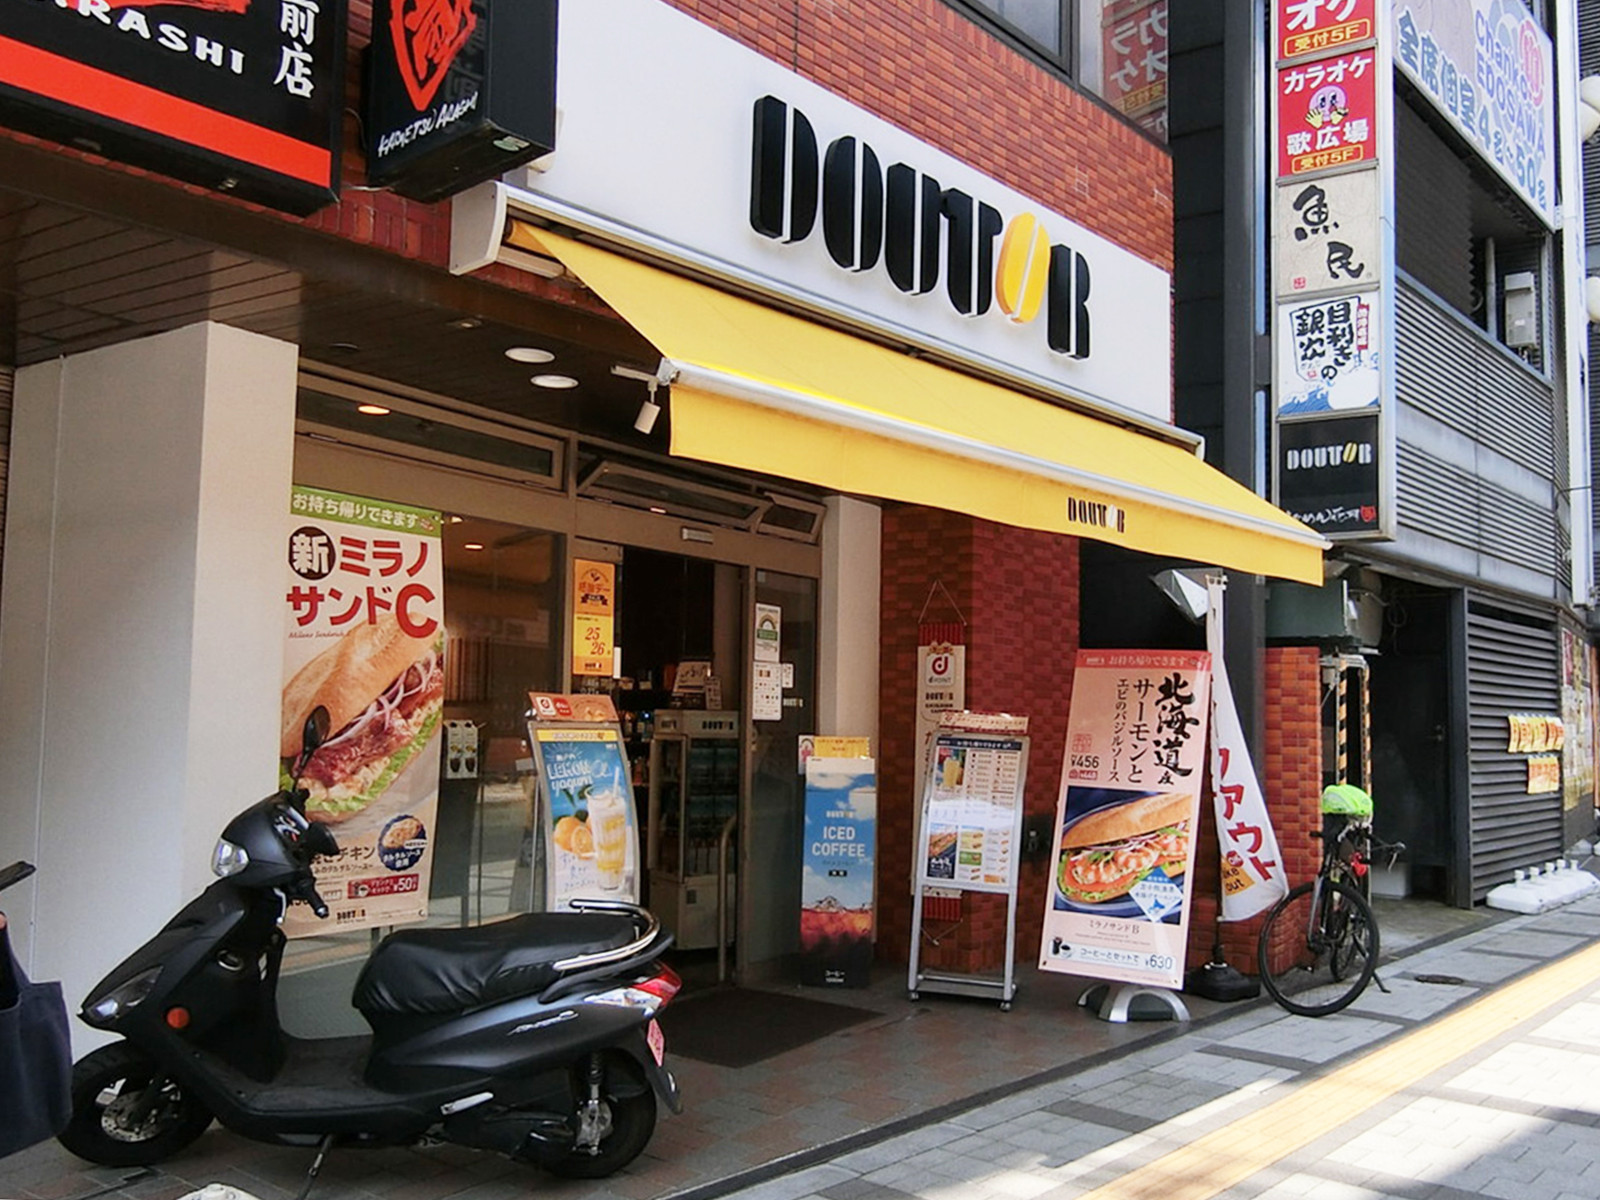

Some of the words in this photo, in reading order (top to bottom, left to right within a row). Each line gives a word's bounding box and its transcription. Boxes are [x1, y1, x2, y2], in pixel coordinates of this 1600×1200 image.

[54, 0, 244, 74] RASHI
[1294, 24, 1360, 52] 受付5F
[1284, 56, 1373, 94] カラオケ
[1286, 119, 1369, 156] 歌広場
[1300, 149, 1354, 170] 受付5F
[749, 94, 1091, 361] DOUTOR
[1293, 184, 1365, 280] 魚民
[1295, 309, 1326, 361] 銀次
[1321, 301, 1354, 380] 目利きの
[1286, 442, 1372, 470] DOUTOR
[292, 494, 418, 528] お持ち帰りできます
[1067, 496, 1125, 534] DOUTOR
[340, 536, 428, 578] ミラノ
[286, 583, 438, 639] サンドC
[585, 627, 600, 641] 25
[590, 641, 606, 656] 26
[1108, 654, 1187, 668] お持ち帰りできます
[1108, 678, 1130, 783] エビのバジルソース
[1127, 678, 1155, 784] サーモンと
[1070, 753, 1100, 769] ¥456
[812, 842, 865, 858] COFFEE
[823, 826, 856, 841] ICED
[1144, 954, 1173, 970] ¥630
